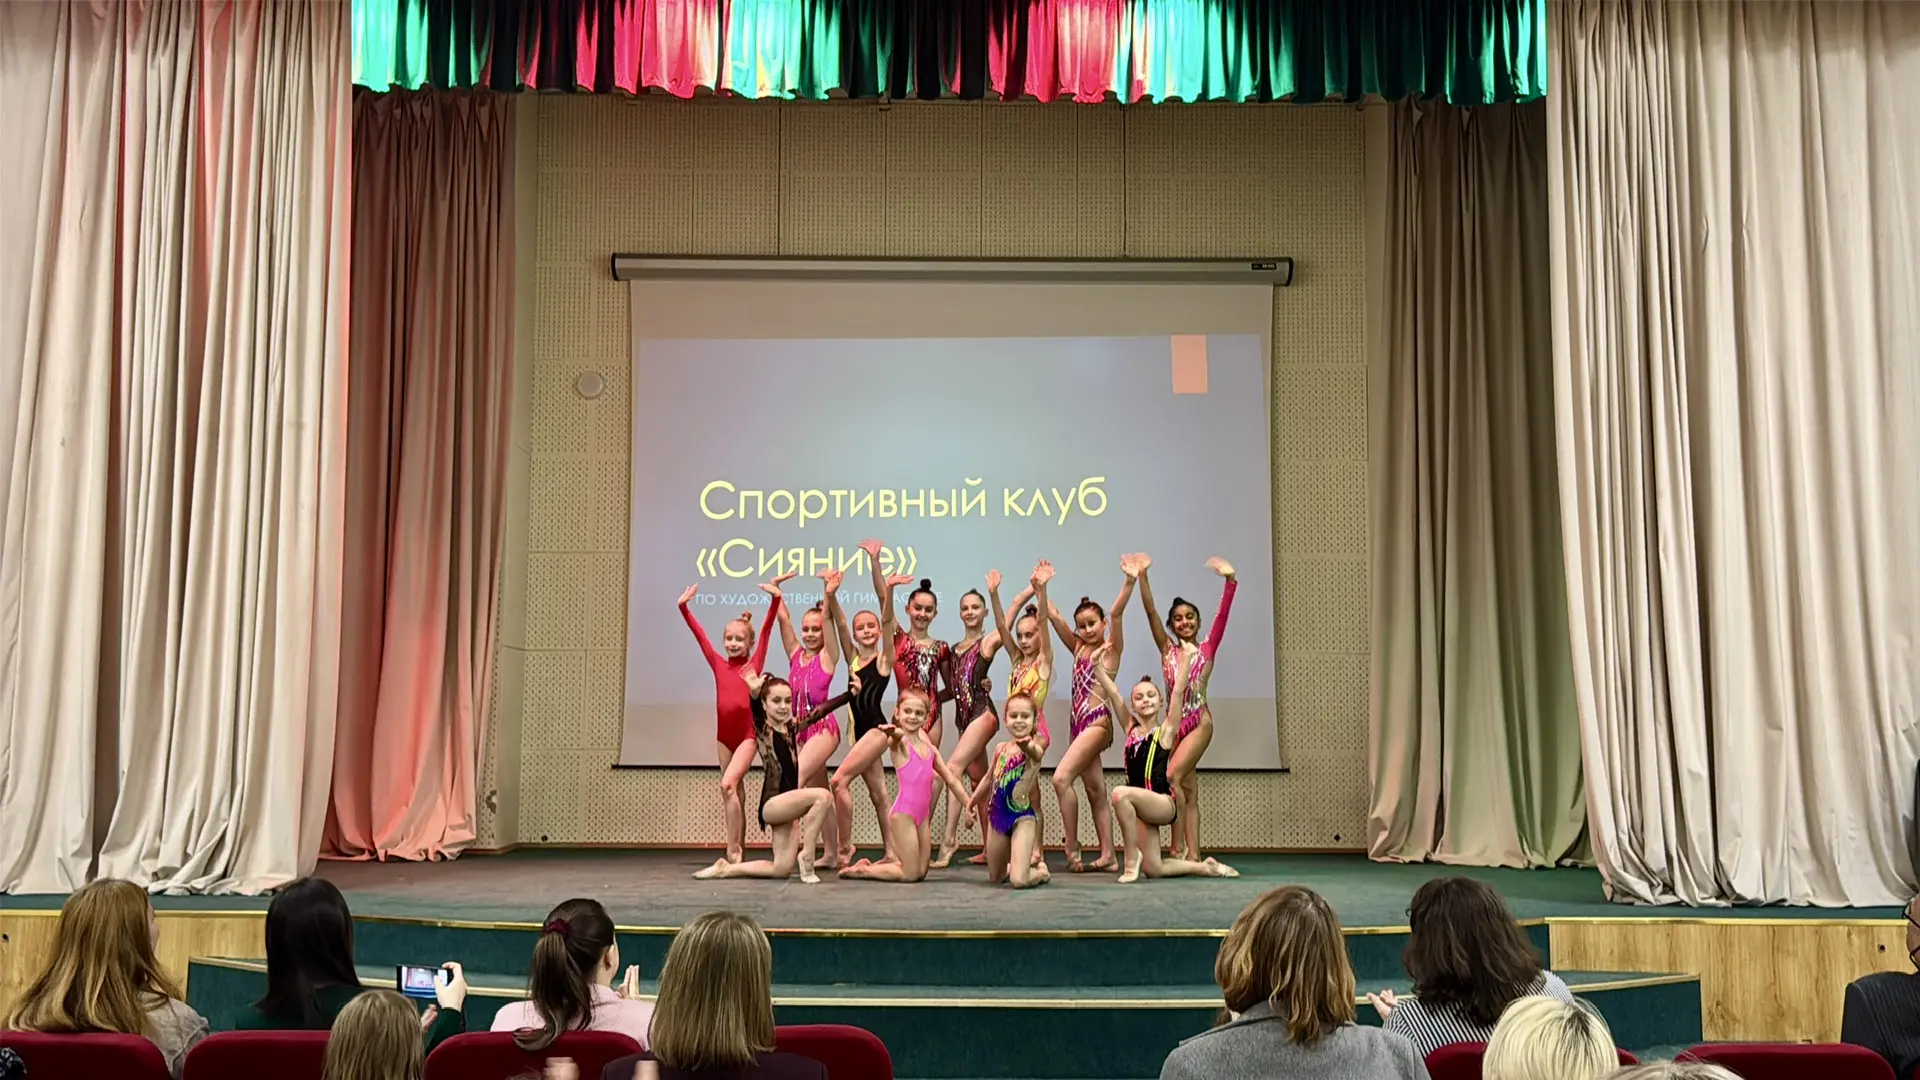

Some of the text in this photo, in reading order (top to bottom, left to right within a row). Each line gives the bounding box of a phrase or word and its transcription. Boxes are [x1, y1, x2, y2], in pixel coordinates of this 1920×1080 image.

[700, 476, 1108, 528] Спортивный клуб
[696, 538, 918, 578] «Сияние»
[695, 593, 716, 606] ПО
[720, 591, 850, 606] ХУДОЖСТВЕНЙ
